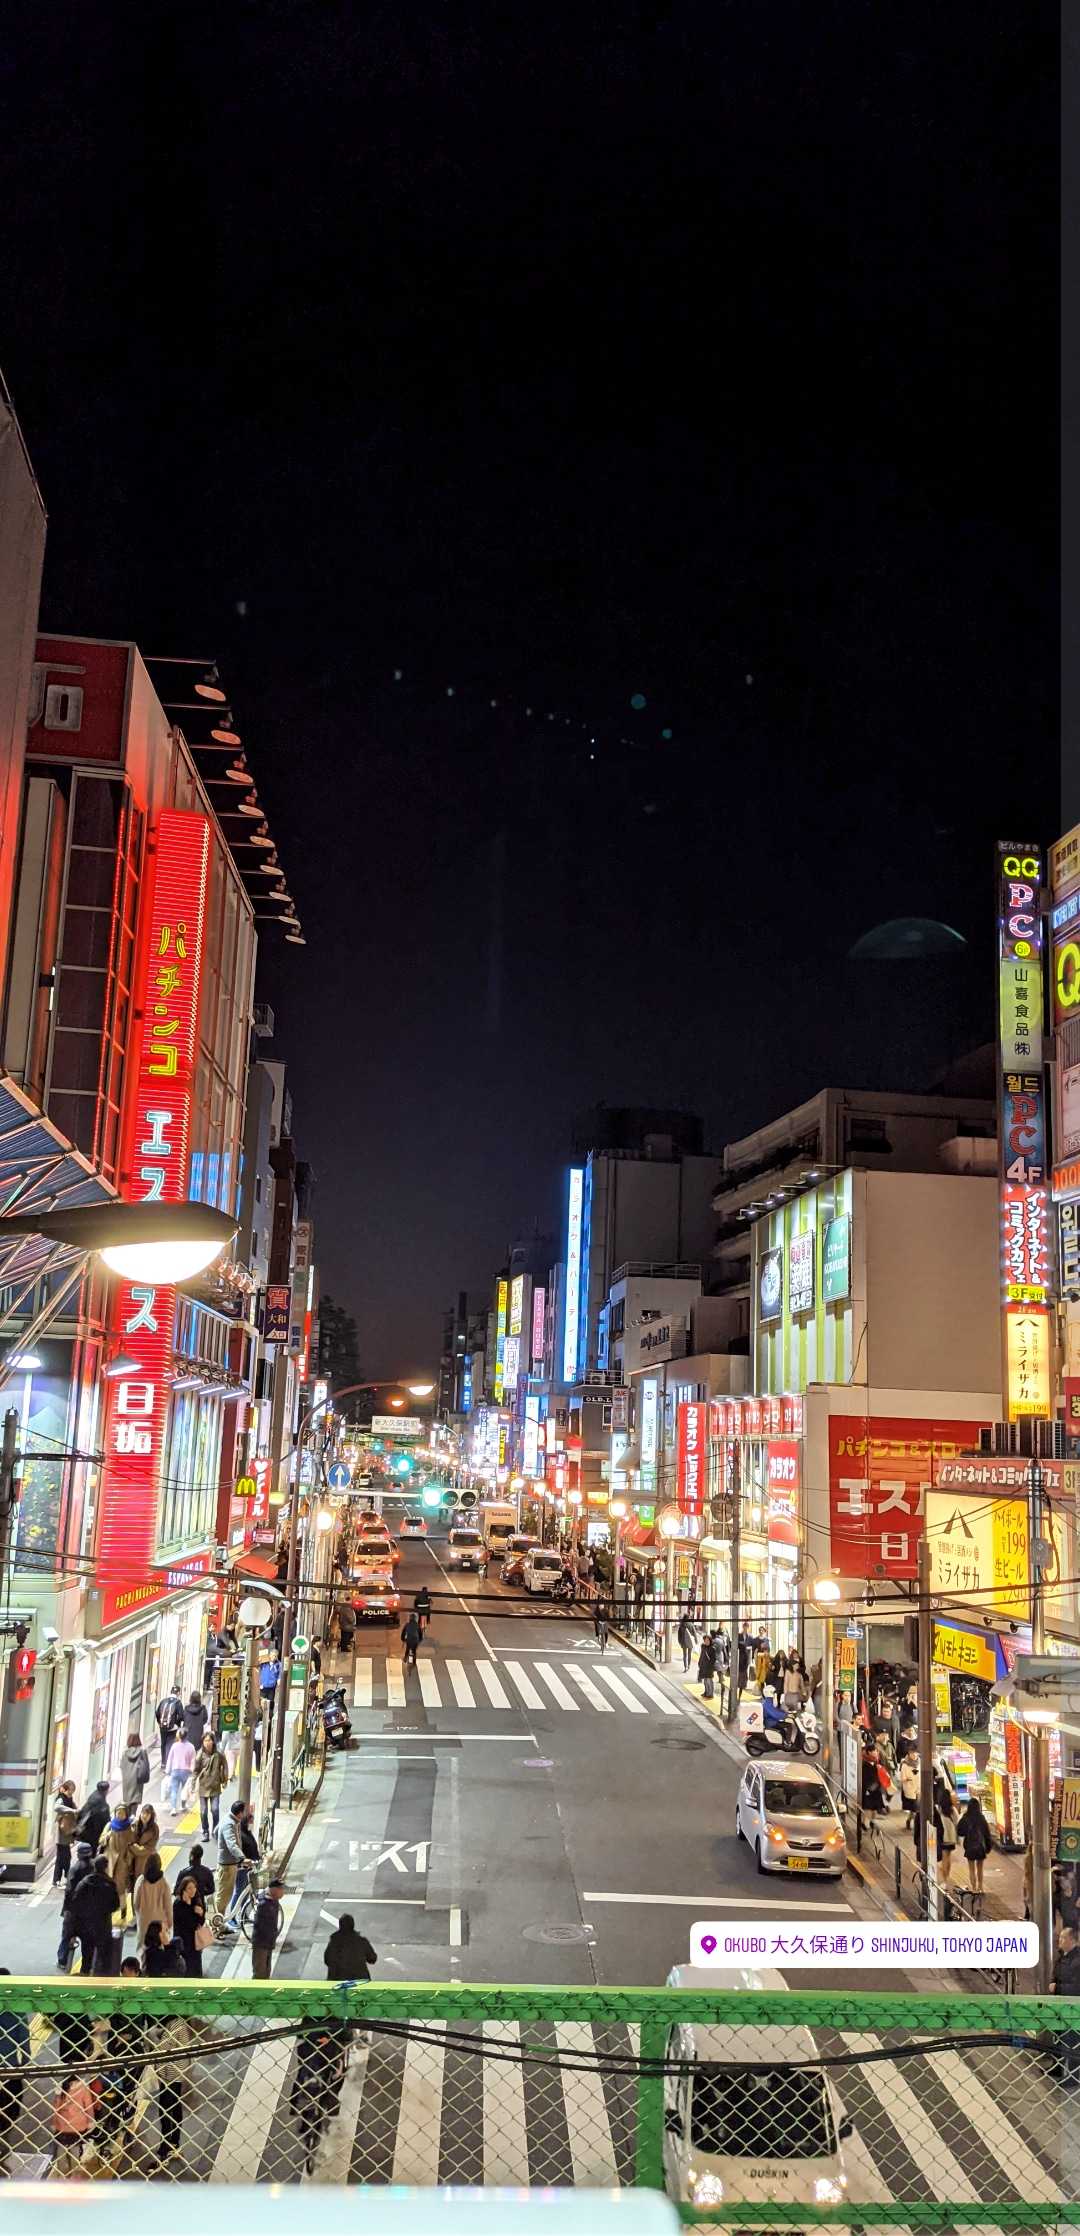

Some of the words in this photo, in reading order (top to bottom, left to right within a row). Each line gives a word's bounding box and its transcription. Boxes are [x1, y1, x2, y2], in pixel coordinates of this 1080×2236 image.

[1003, 856, 1040, 878] QQ
[147, 922, 189, 1077] パチンコ
[1007, 1075, 1040, 1093] 월드
[1006, 1156, 1042, 1184] 4F
[126, 1110, 172, 1335] エスス
[1008, 1201, 1026, 1284] コミックカフェ
[1025, 1191, 1042, 1284] インターネット&
[1017, 1332, 1029, 1399] ミライザカ
[686, 1406, 698, 1451] カラオケ
[769, 1456, 796, 1481] カラオケ
[993, 1508, 1024, 1529] ハイボール
[938, 1559, 980, 1590] ミライザカ
[994, 1558, 1025, 1580] 生ビール
[222, 1676, 239, 1701] 102
[749, 2168, 789, 2179] DUSKIN
